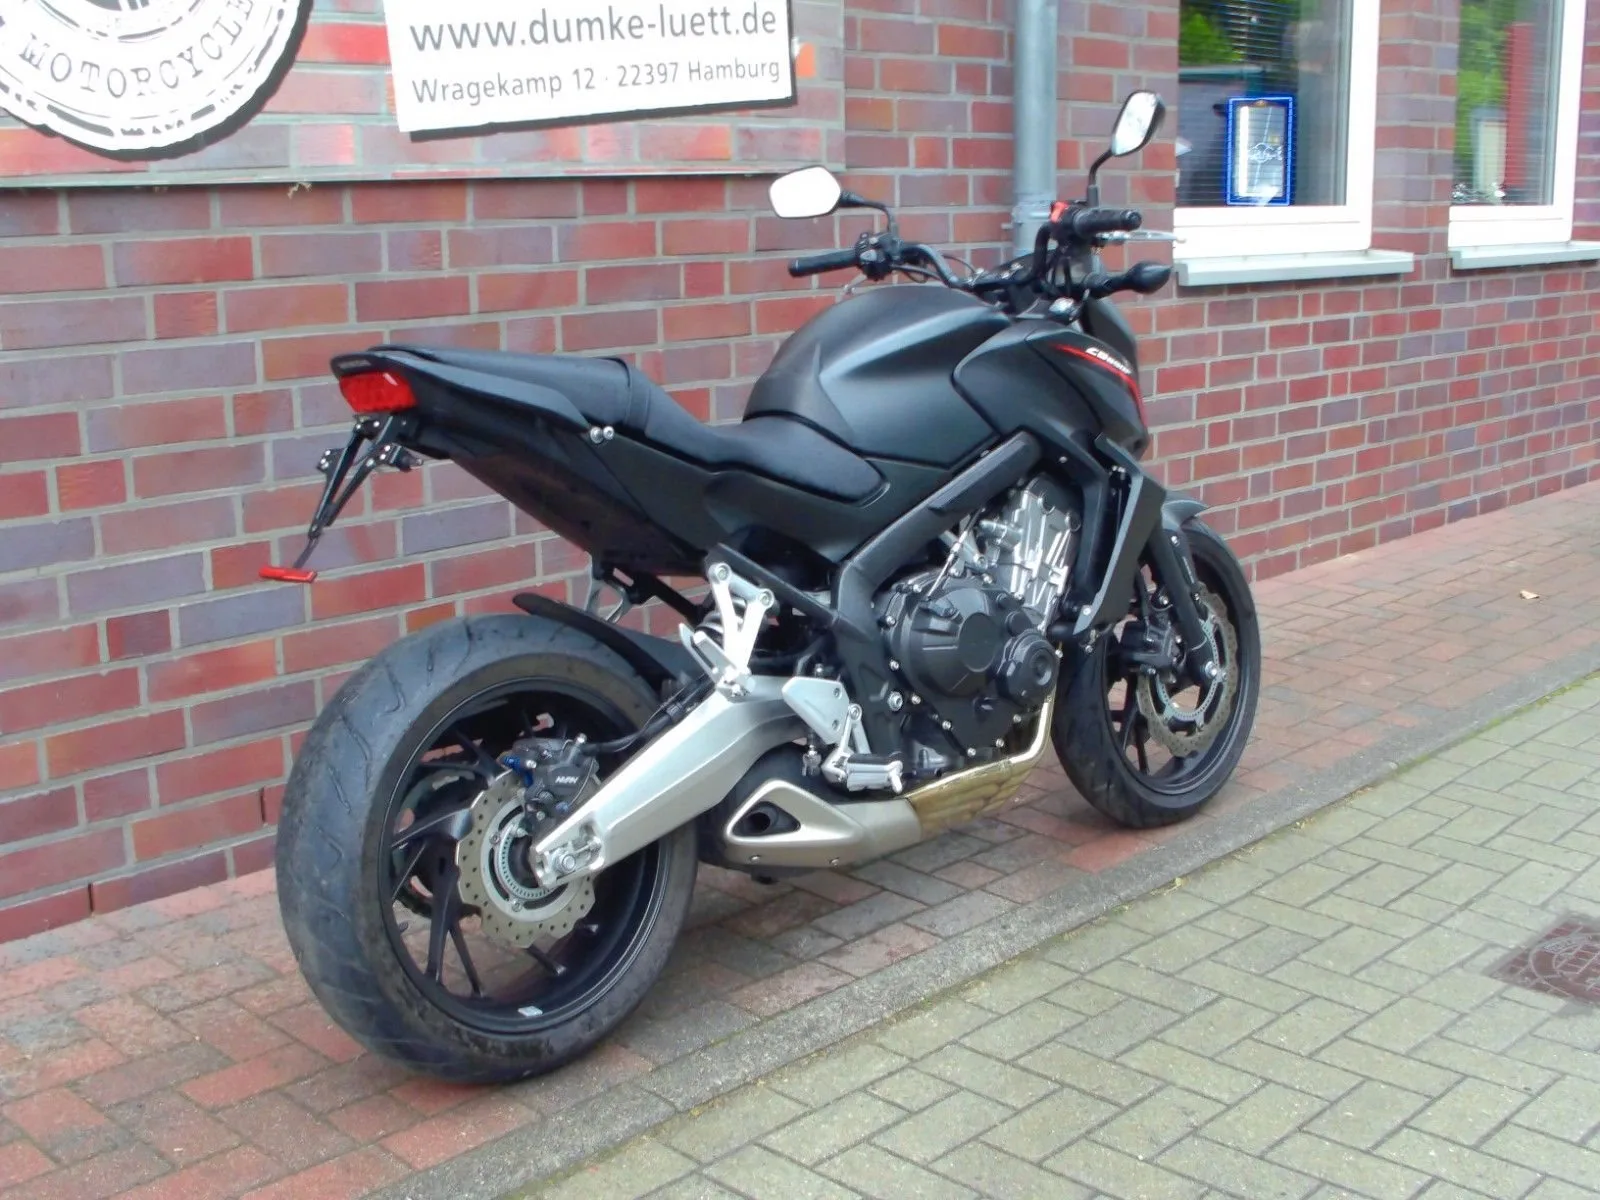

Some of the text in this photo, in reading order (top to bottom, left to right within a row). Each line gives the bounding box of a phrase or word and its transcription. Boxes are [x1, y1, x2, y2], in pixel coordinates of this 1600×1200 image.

[410, 2, 777, 51] www.dumke-luett.de
[411, 58, 780, 106] Wragekamp 12 22397 Hamburg
